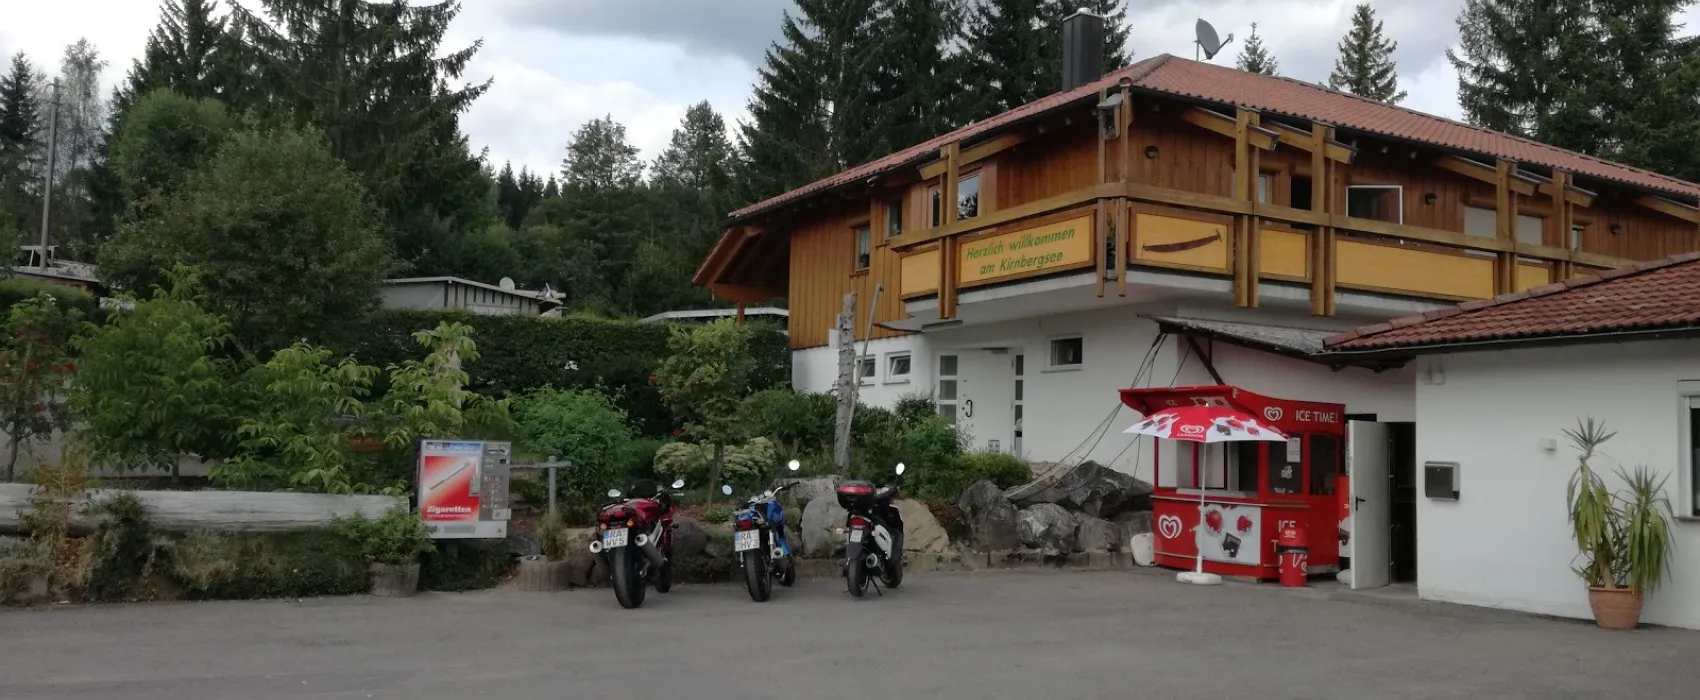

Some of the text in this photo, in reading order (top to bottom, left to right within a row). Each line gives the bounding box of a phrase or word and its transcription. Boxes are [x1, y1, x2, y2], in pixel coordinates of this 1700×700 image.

[966, 228, 1075, 260] Herzlich willkommen
[980, 251, 1064, 275] am Kirnbergsee
[1295, 410, 1339, 423] ICE TIME!
[427, 505, 471, 514] Zigaretten
[610, 529, 622, 538] RA
[740, 531, 752, 540] RA
